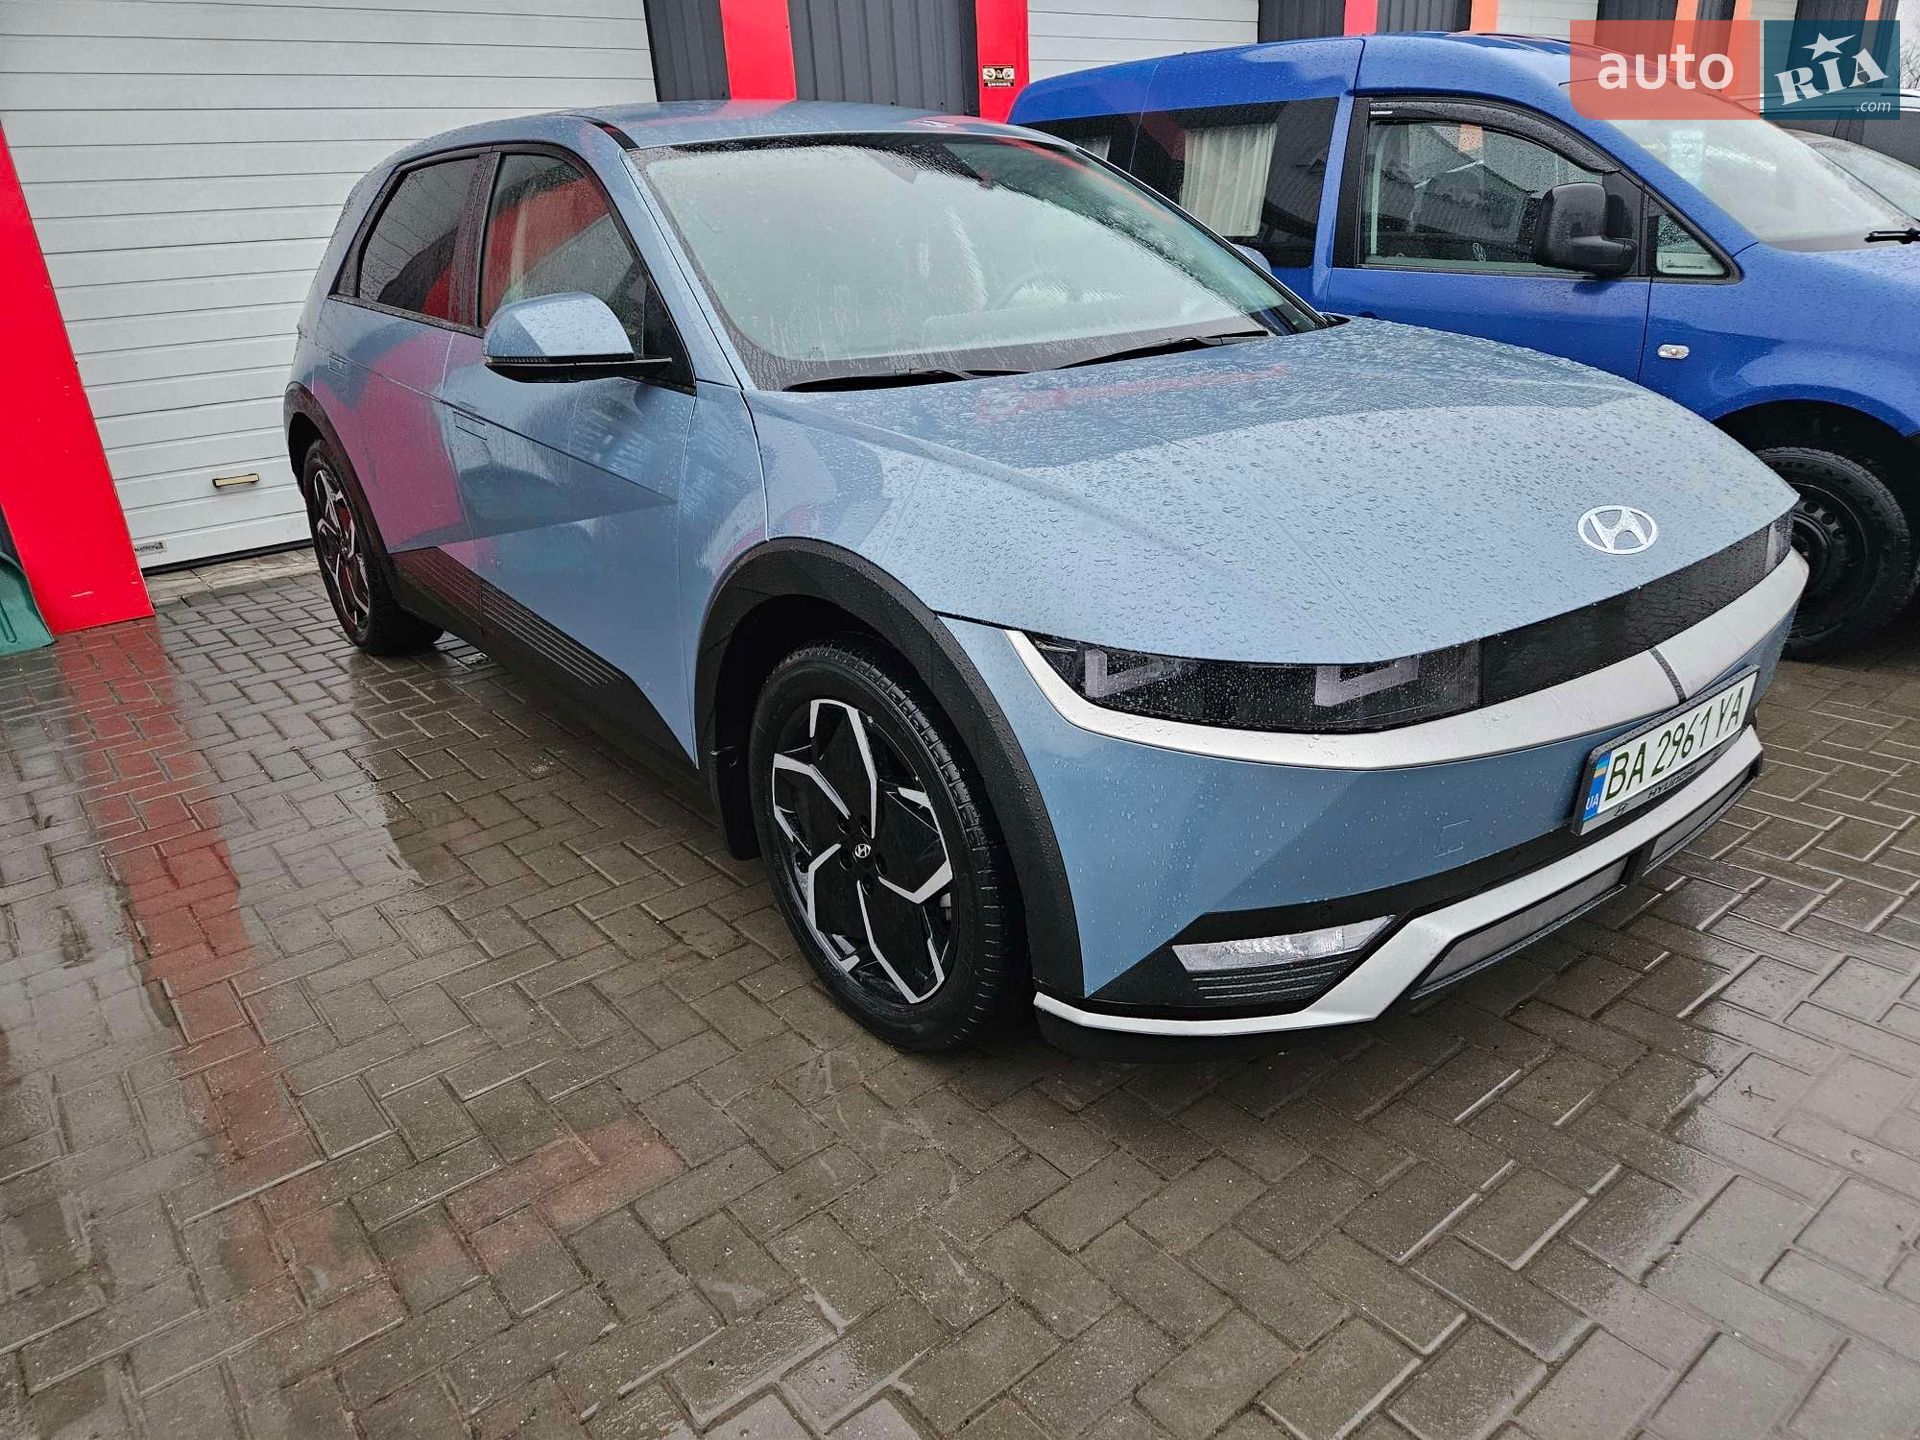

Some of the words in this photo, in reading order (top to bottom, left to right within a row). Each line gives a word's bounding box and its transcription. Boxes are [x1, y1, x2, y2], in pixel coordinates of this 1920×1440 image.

[1605, 741, 1648, 801] BA
[1651, 705, 1713, 777] 2961
[1585, 793, 1600, 810] UA
